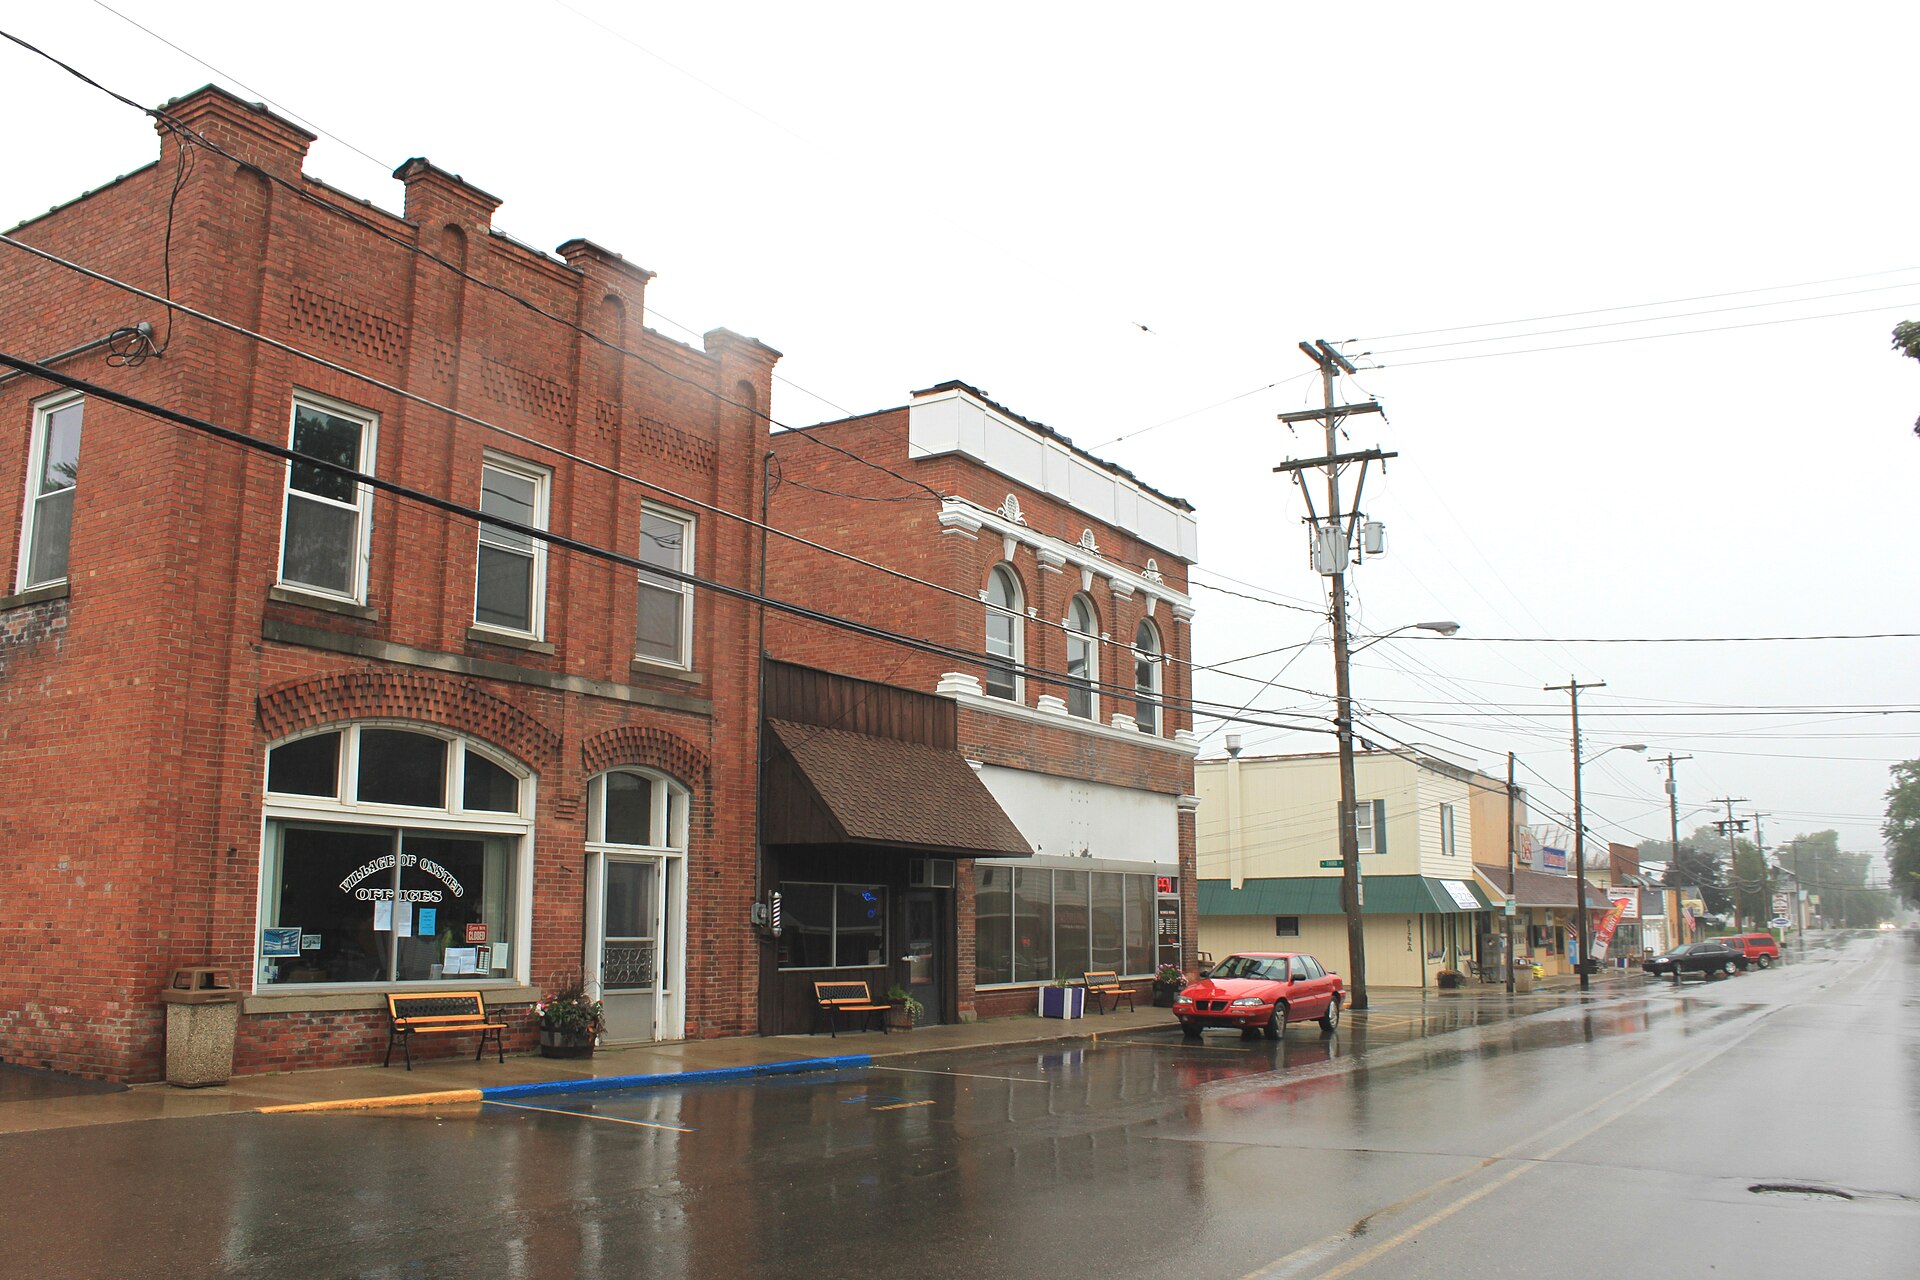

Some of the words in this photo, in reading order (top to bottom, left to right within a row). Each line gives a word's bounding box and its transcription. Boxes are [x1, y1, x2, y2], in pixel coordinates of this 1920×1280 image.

[338, 854, 396, 894] VILLAGE
[400, 854, 417, 867] OF
[419, 857, 464, 898] ONSTED
[355, 887, 443, 903] OFFICES
